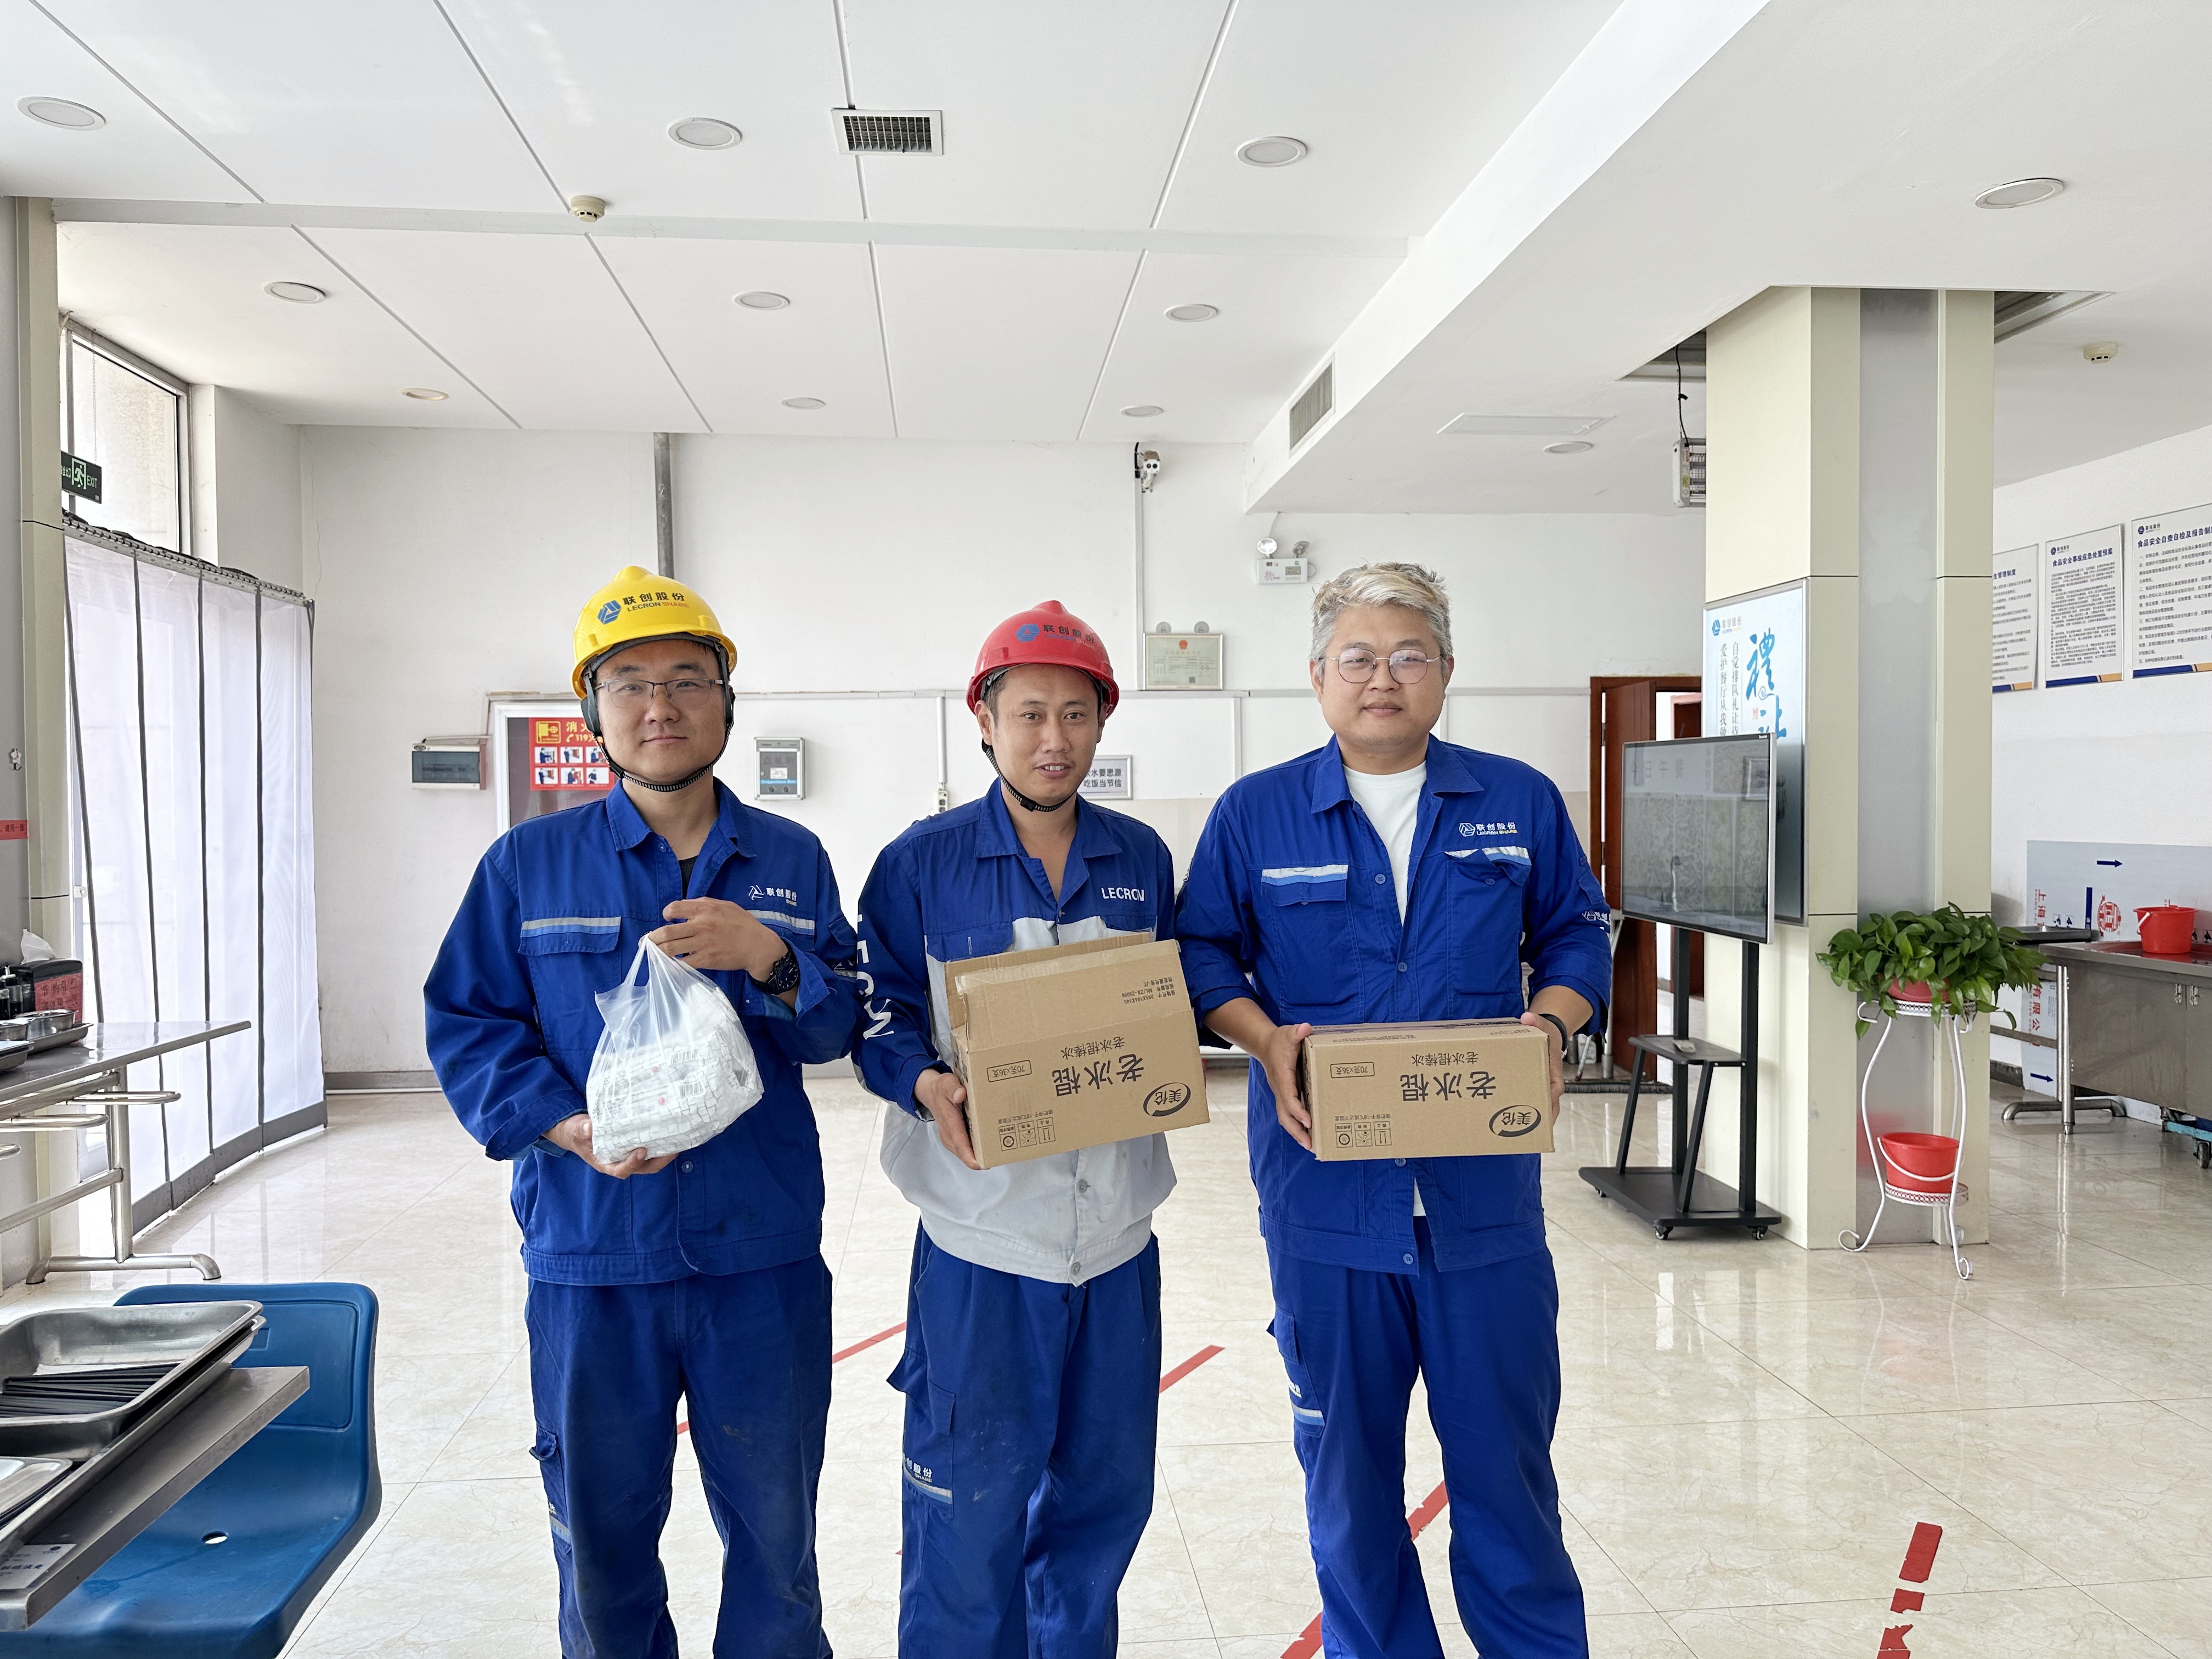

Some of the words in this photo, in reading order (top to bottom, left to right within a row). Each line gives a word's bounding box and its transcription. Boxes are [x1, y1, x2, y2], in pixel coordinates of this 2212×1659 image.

[87, 475, 98, 488] EXIT
[2137, 526, 2212, 548] 食品安全自查自检及报告制
[623, 592, 685, 605] 联创股份
[627, 602, 661, 612] LECRON
[1043, 624, 1094, 644] 联创股份
[1084, 779, 1122, 787] 吃饭当节俭
[1476, 822, 1515, 831] 联创股份
[766, 888, 797, 901] 联创股份
[1061, 1036, 1125, 1059] 老冰棍棒冰
[1412, 1052, 1479, 1066] 老冰棍棒冰
[1052, 1053, 1144, 1097] 老冰棍
[1400, 1071, 1496, 1102] 老冰棍
[1154, 1088, 1182, 1105] 美伦
[1501, 1111, 1532, 1126] 美伦
